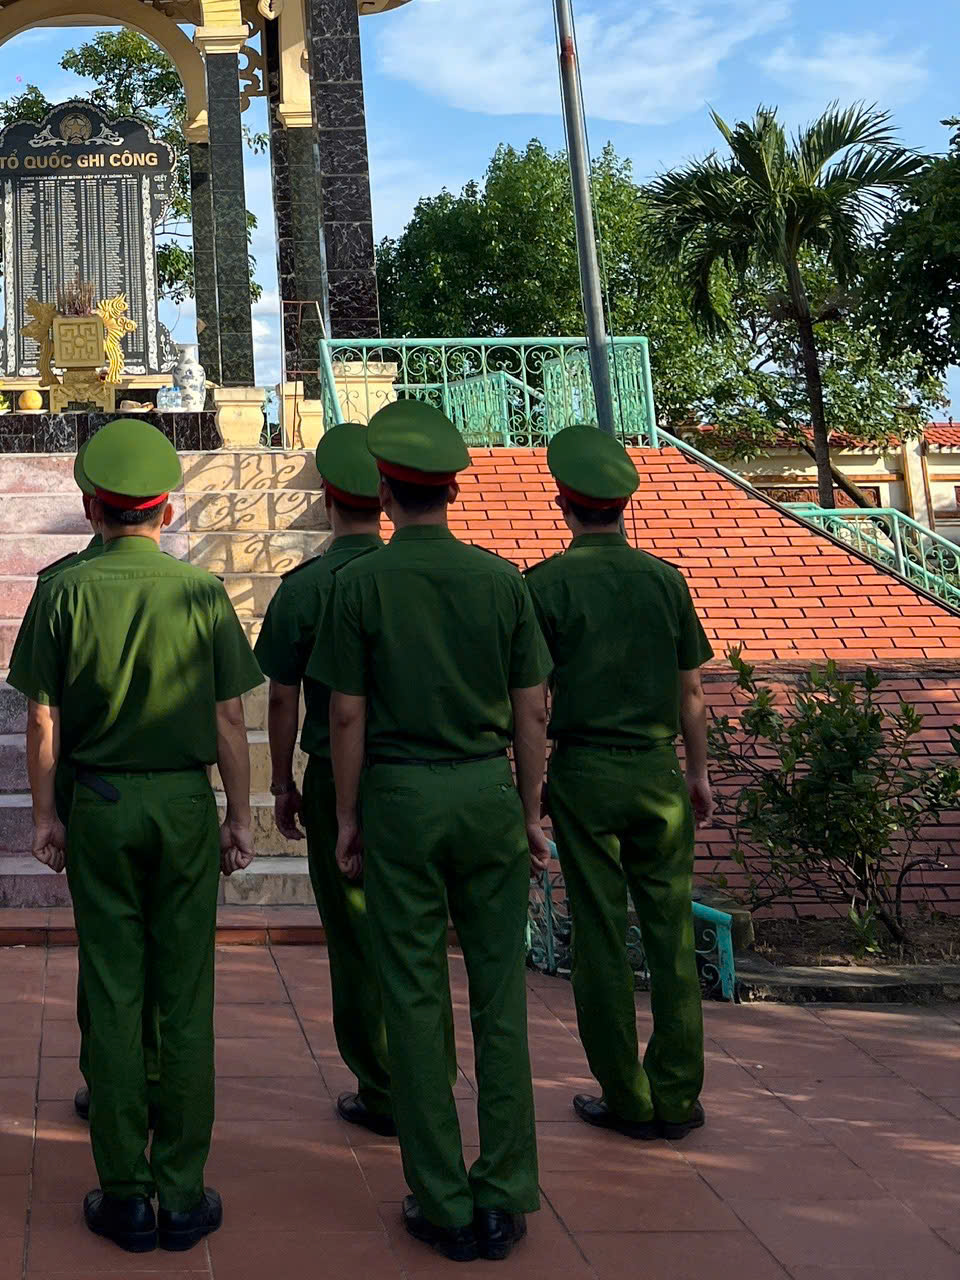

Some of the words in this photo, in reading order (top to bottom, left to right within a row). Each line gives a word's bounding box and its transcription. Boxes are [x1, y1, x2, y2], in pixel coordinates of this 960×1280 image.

[24, 149, 72, 169] QUỐC
[77, 153, 105, 167] GHI
[109, 150, 158, 167] CÔNG
